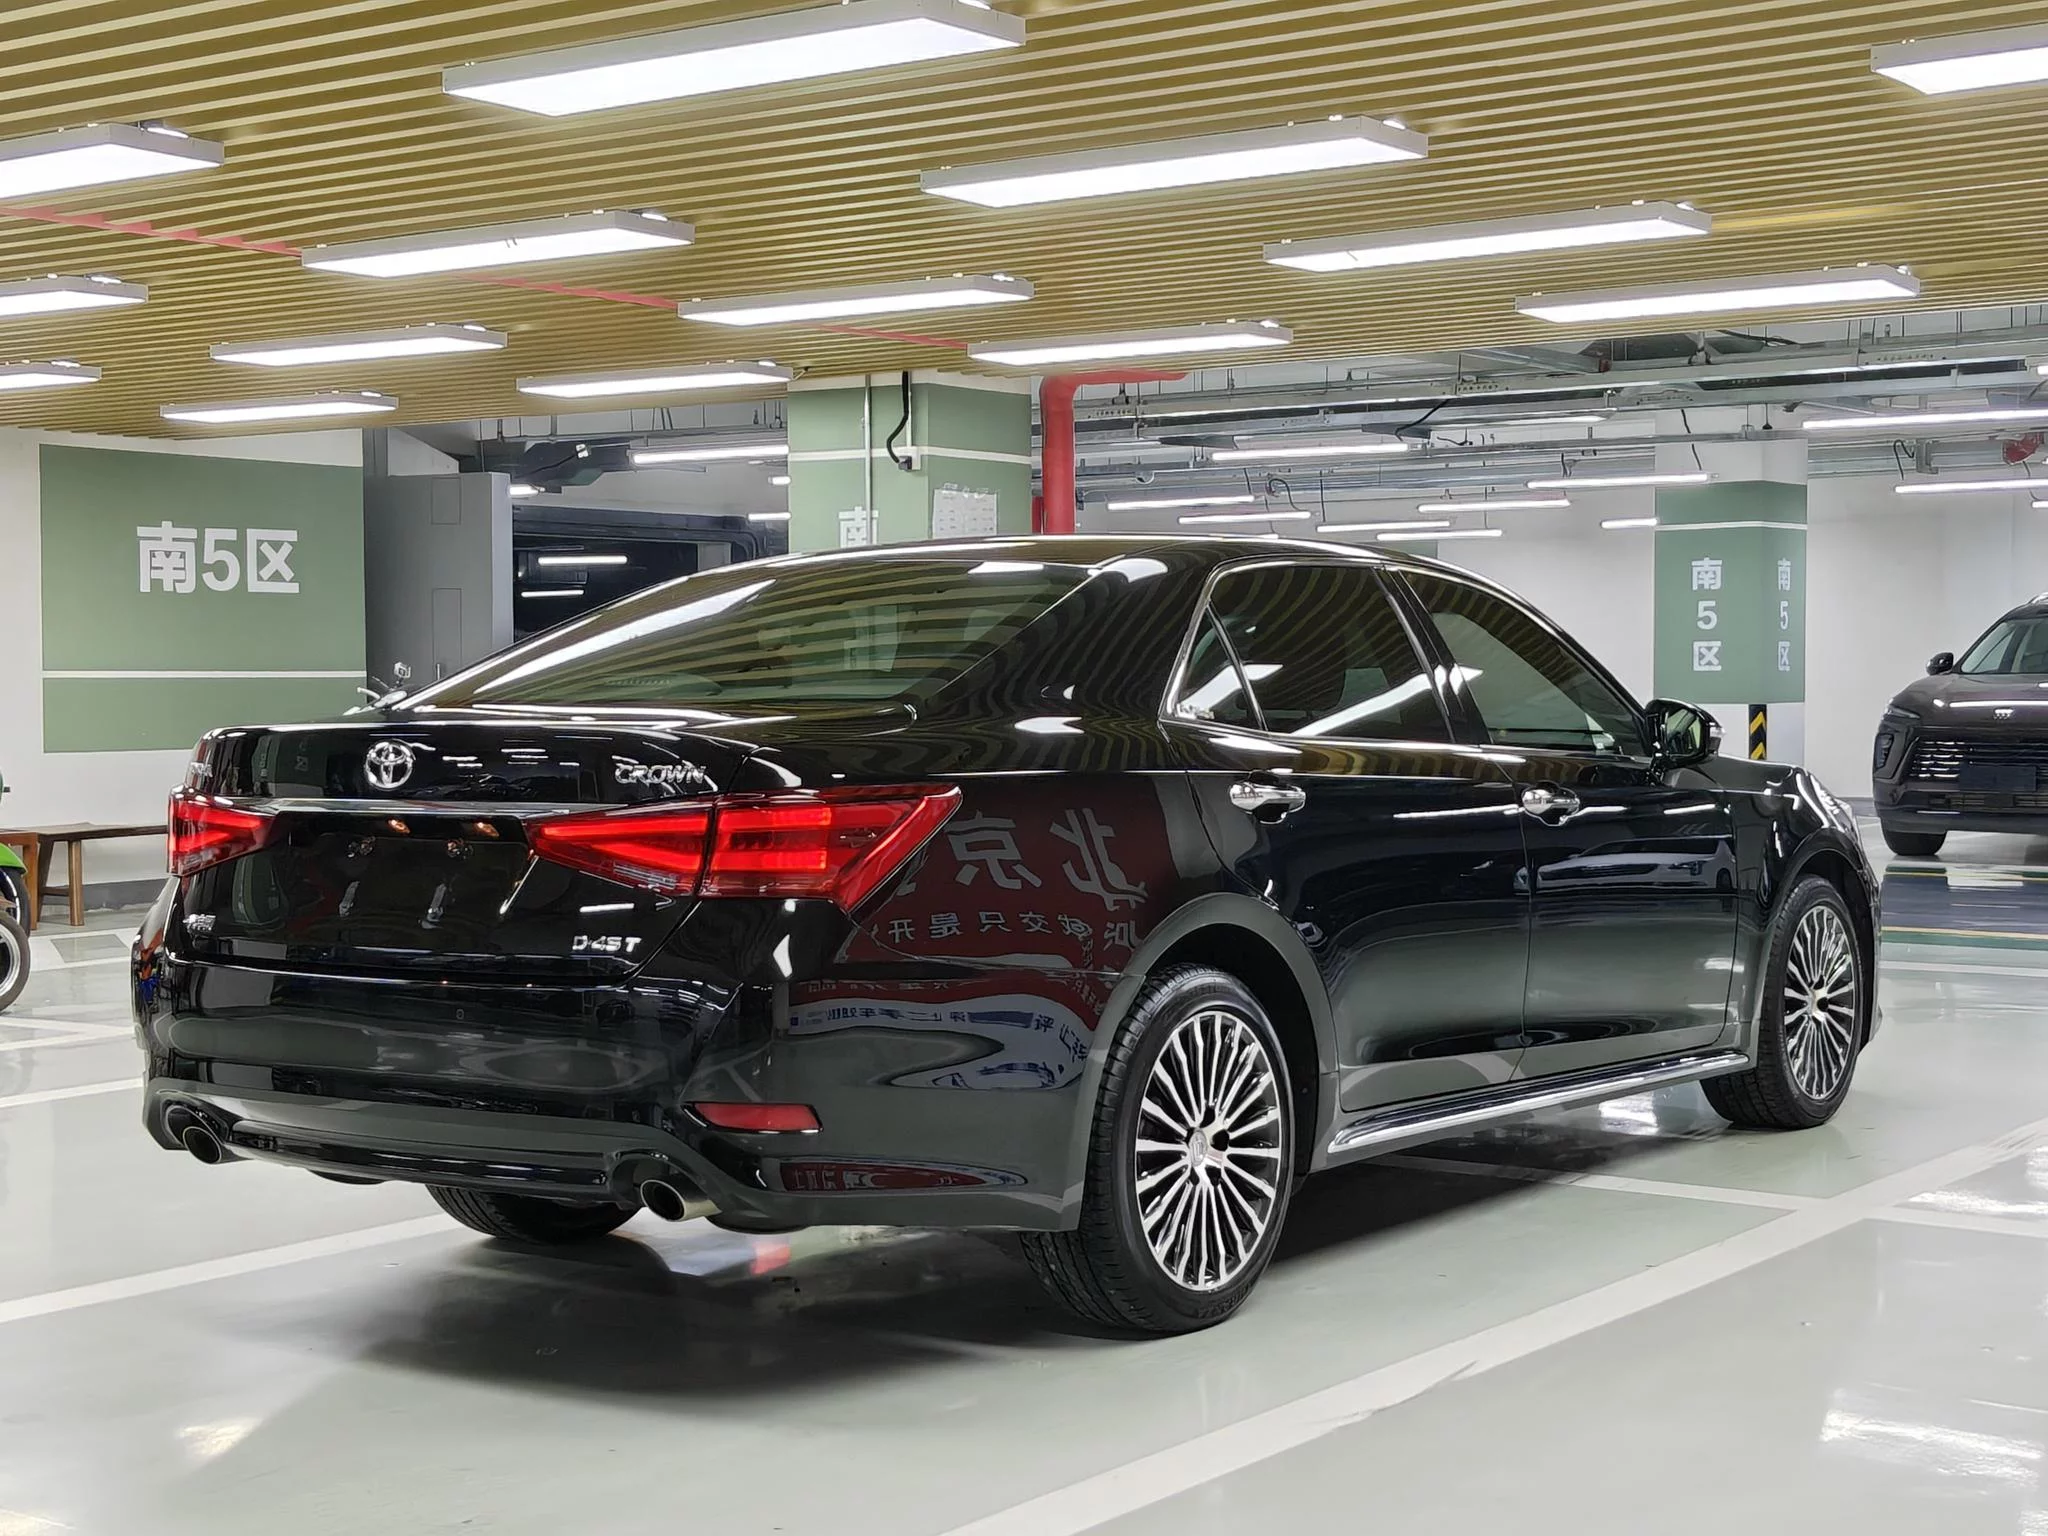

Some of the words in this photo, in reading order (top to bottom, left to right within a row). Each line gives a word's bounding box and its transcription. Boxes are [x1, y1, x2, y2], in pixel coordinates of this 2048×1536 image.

[136, 520, 300, 594] 南5区
[1691, 557, 1723, 672] 南5区
[1777, 557, 1792, 672] 南5区
[614, 763, 707, 785] CROWN
